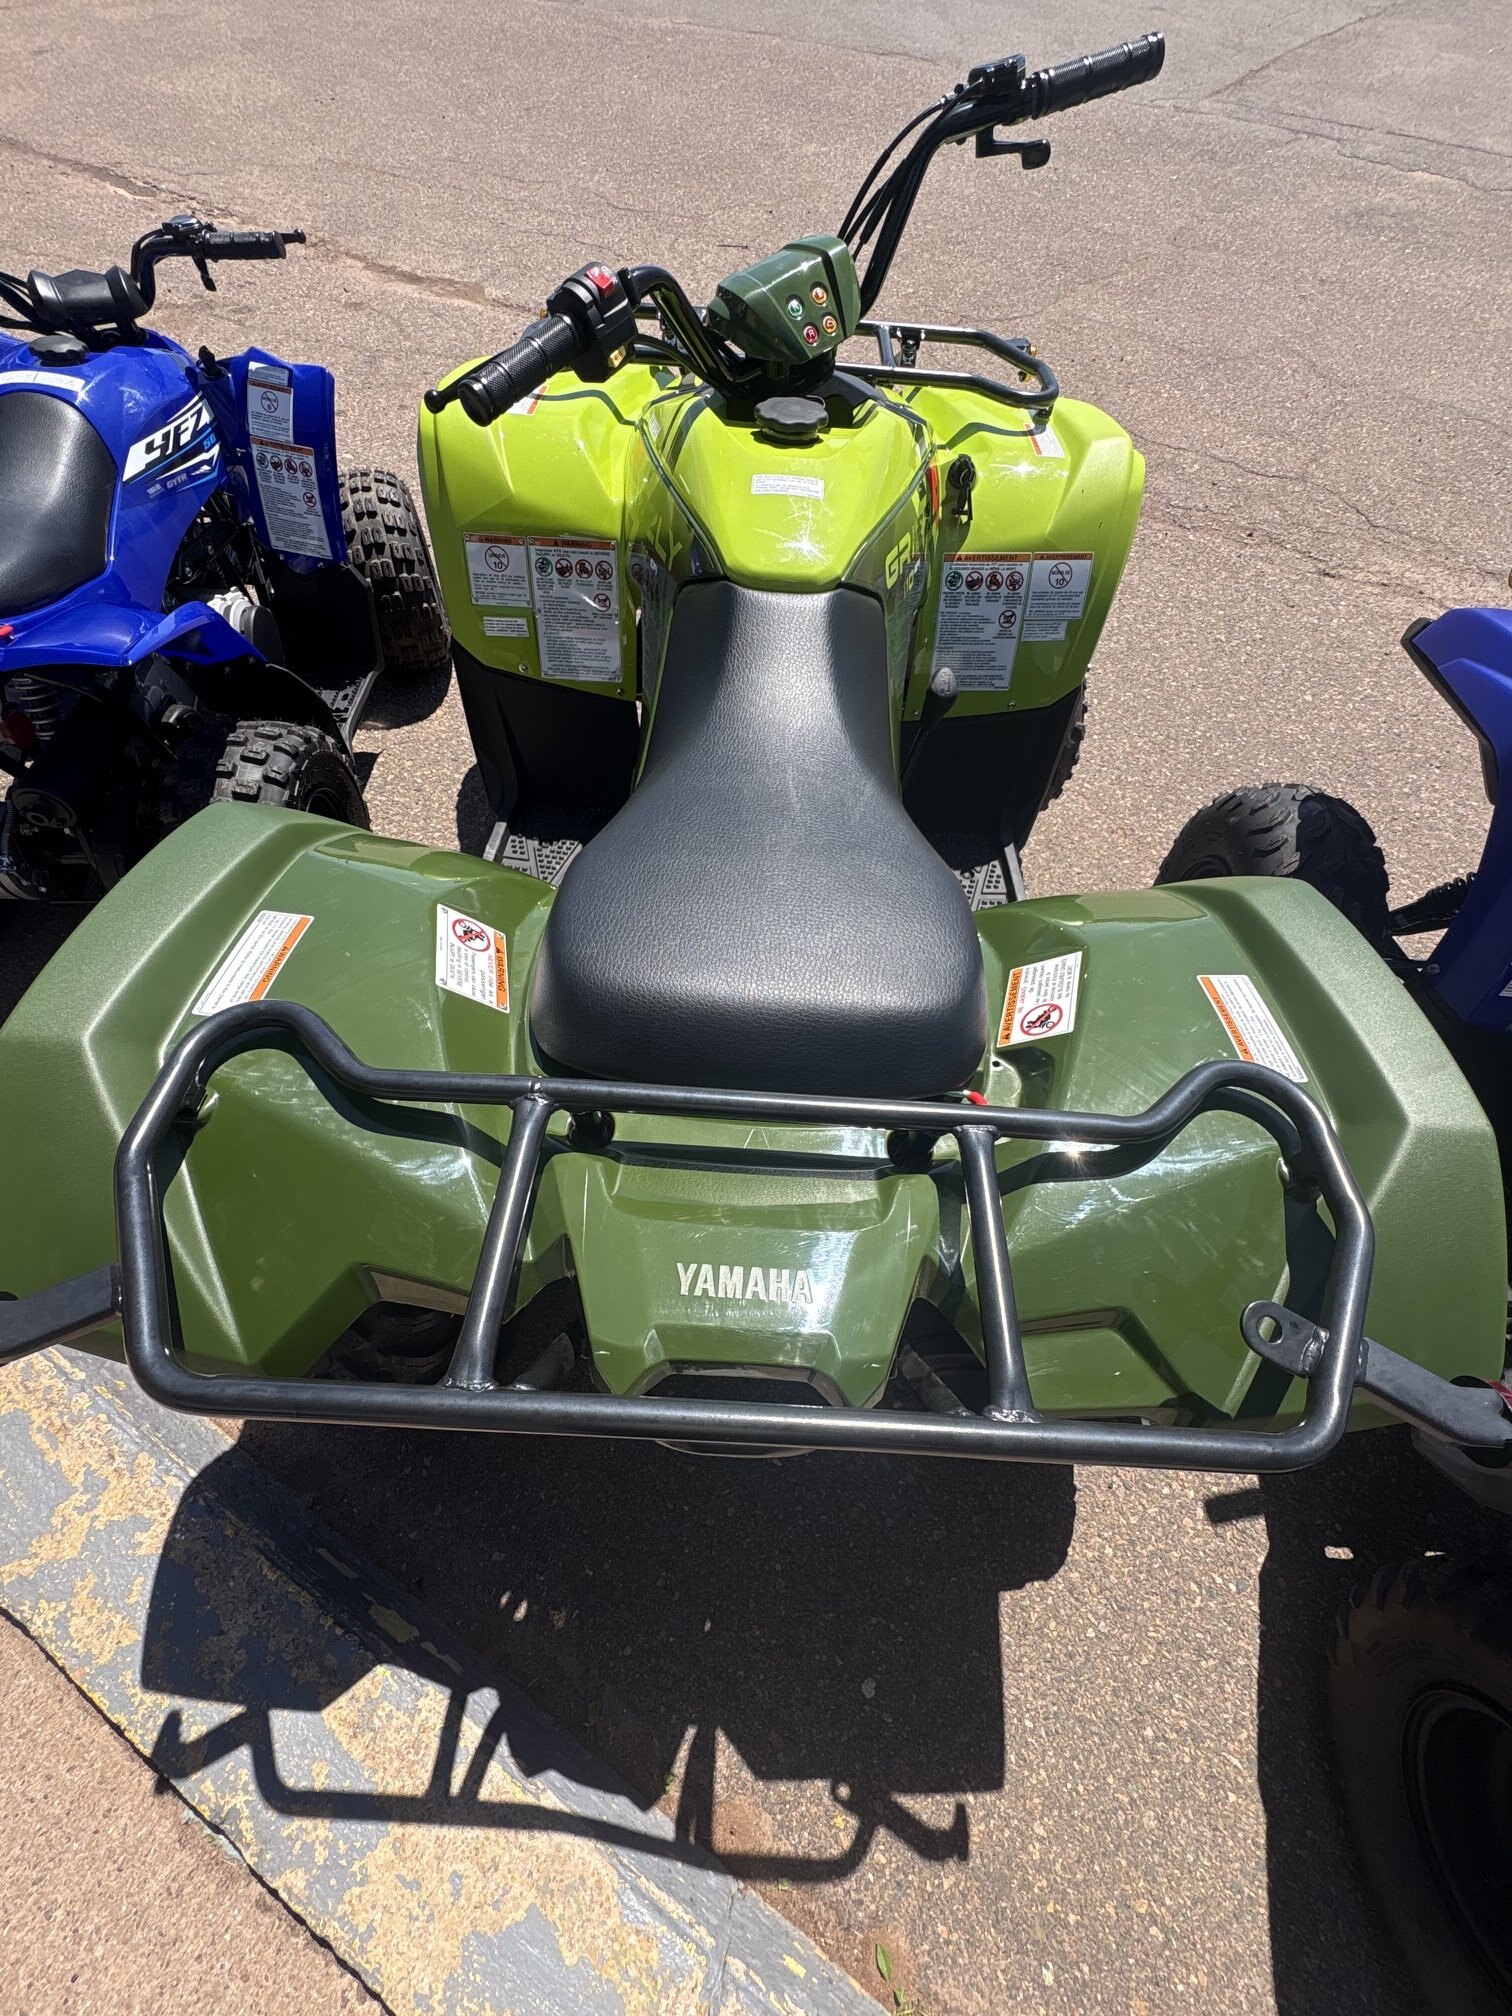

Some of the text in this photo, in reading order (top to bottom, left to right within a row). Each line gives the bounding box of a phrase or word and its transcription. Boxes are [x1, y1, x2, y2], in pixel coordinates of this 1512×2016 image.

[493, 561, 503, 569] 10
[1054, 578, 1065, 586] 10
[263, 952, 286, 983] WARNING
[496, 955, 505, 993] WARNING
[1003, 971, 1020, 1031] AVERTISSEMENT
[1213, 996, 1244, 1047] AVERTISSEMENT
[676, 1262, 813, 1304] YAMAHA
